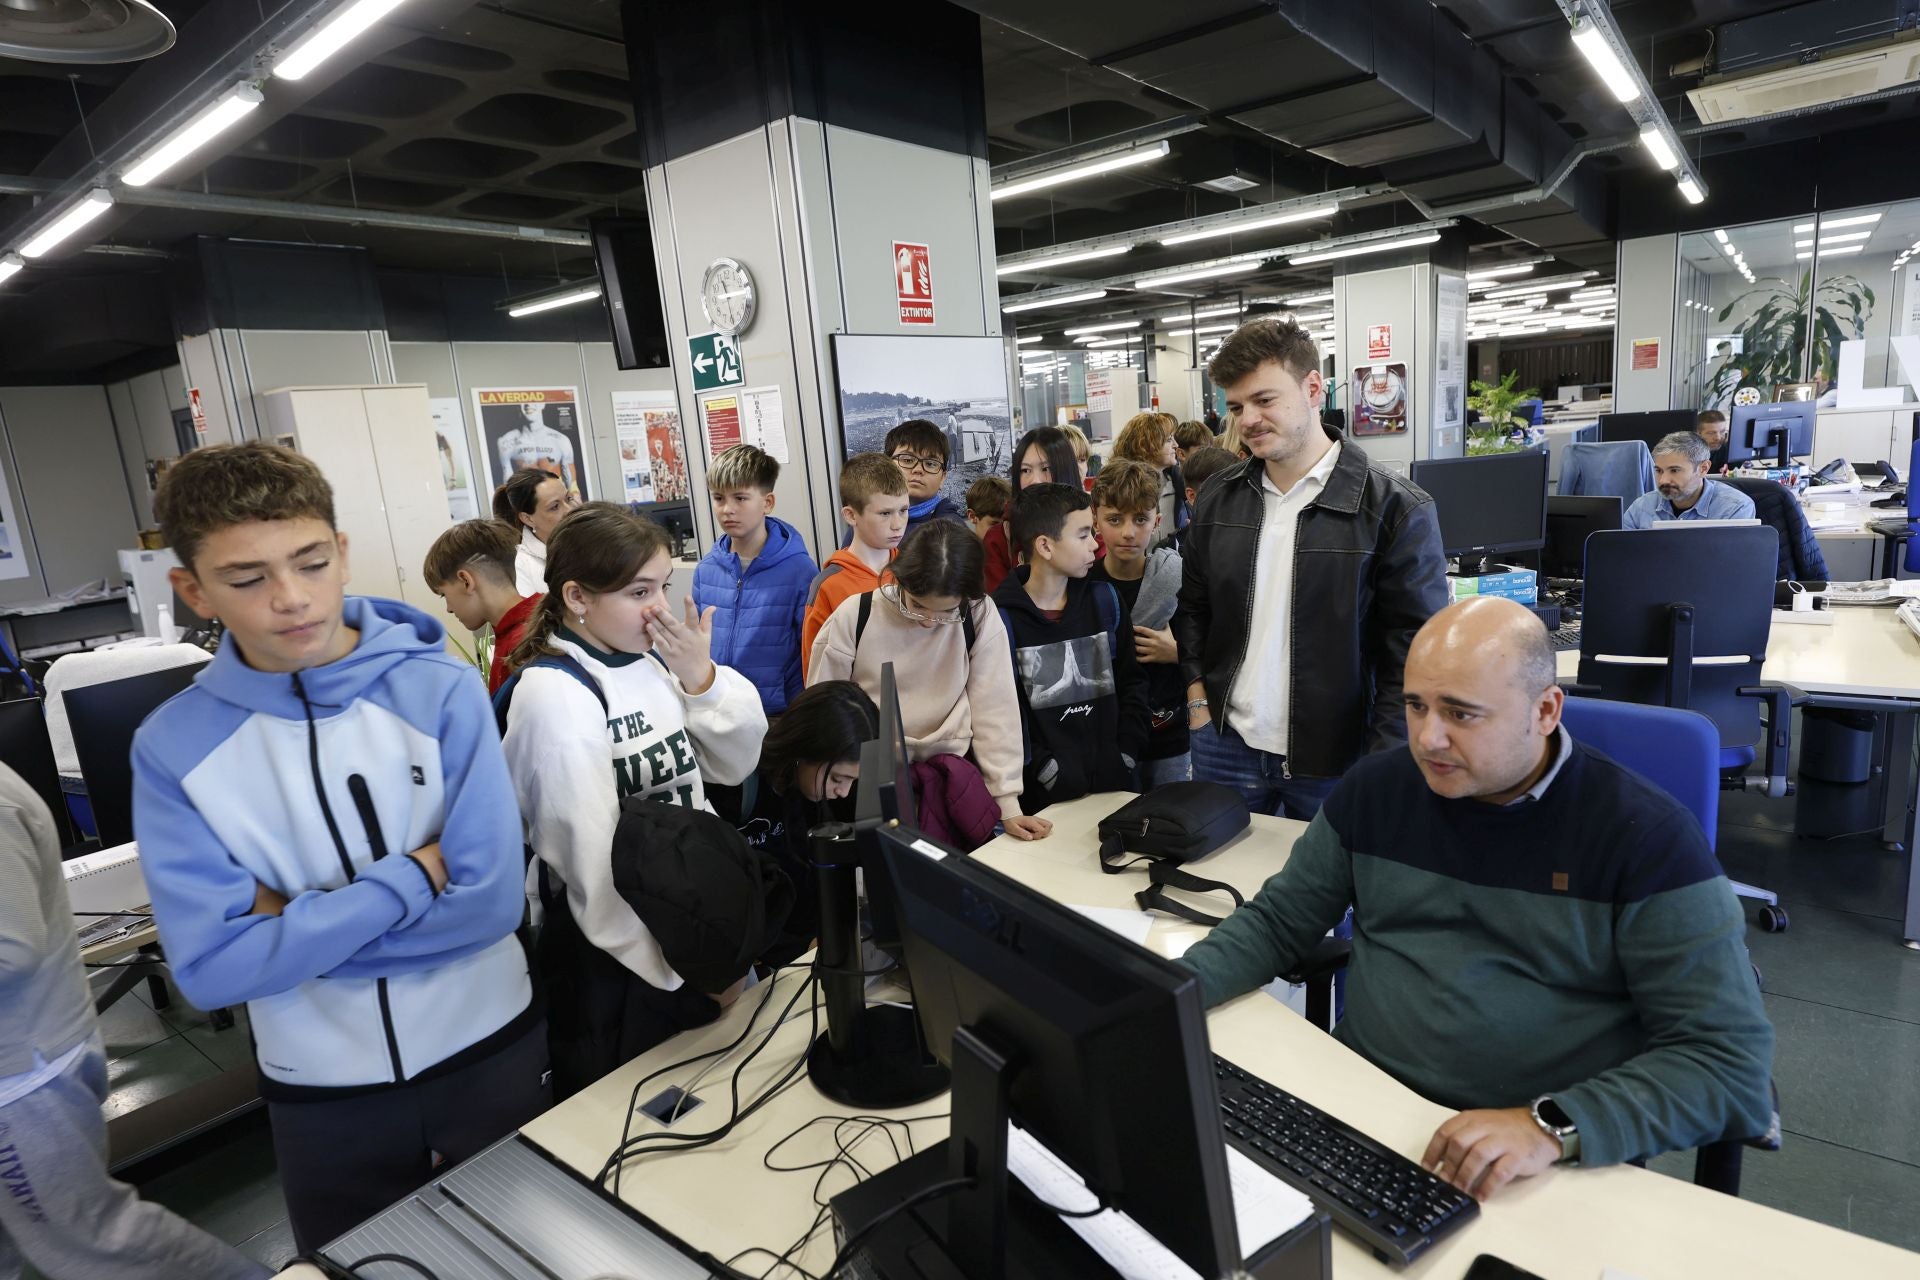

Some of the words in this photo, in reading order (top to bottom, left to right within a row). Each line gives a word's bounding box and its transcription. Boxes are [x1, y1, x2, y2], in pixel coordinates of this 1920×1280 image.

[901, 307, 932, 318] EXTINTOR
[480, 393, 497, 403] LA
[497, 392, 545, 403] VERDAD
[1059, 704, 1095, 722] pray
[607, 711, 654, 743] THE
